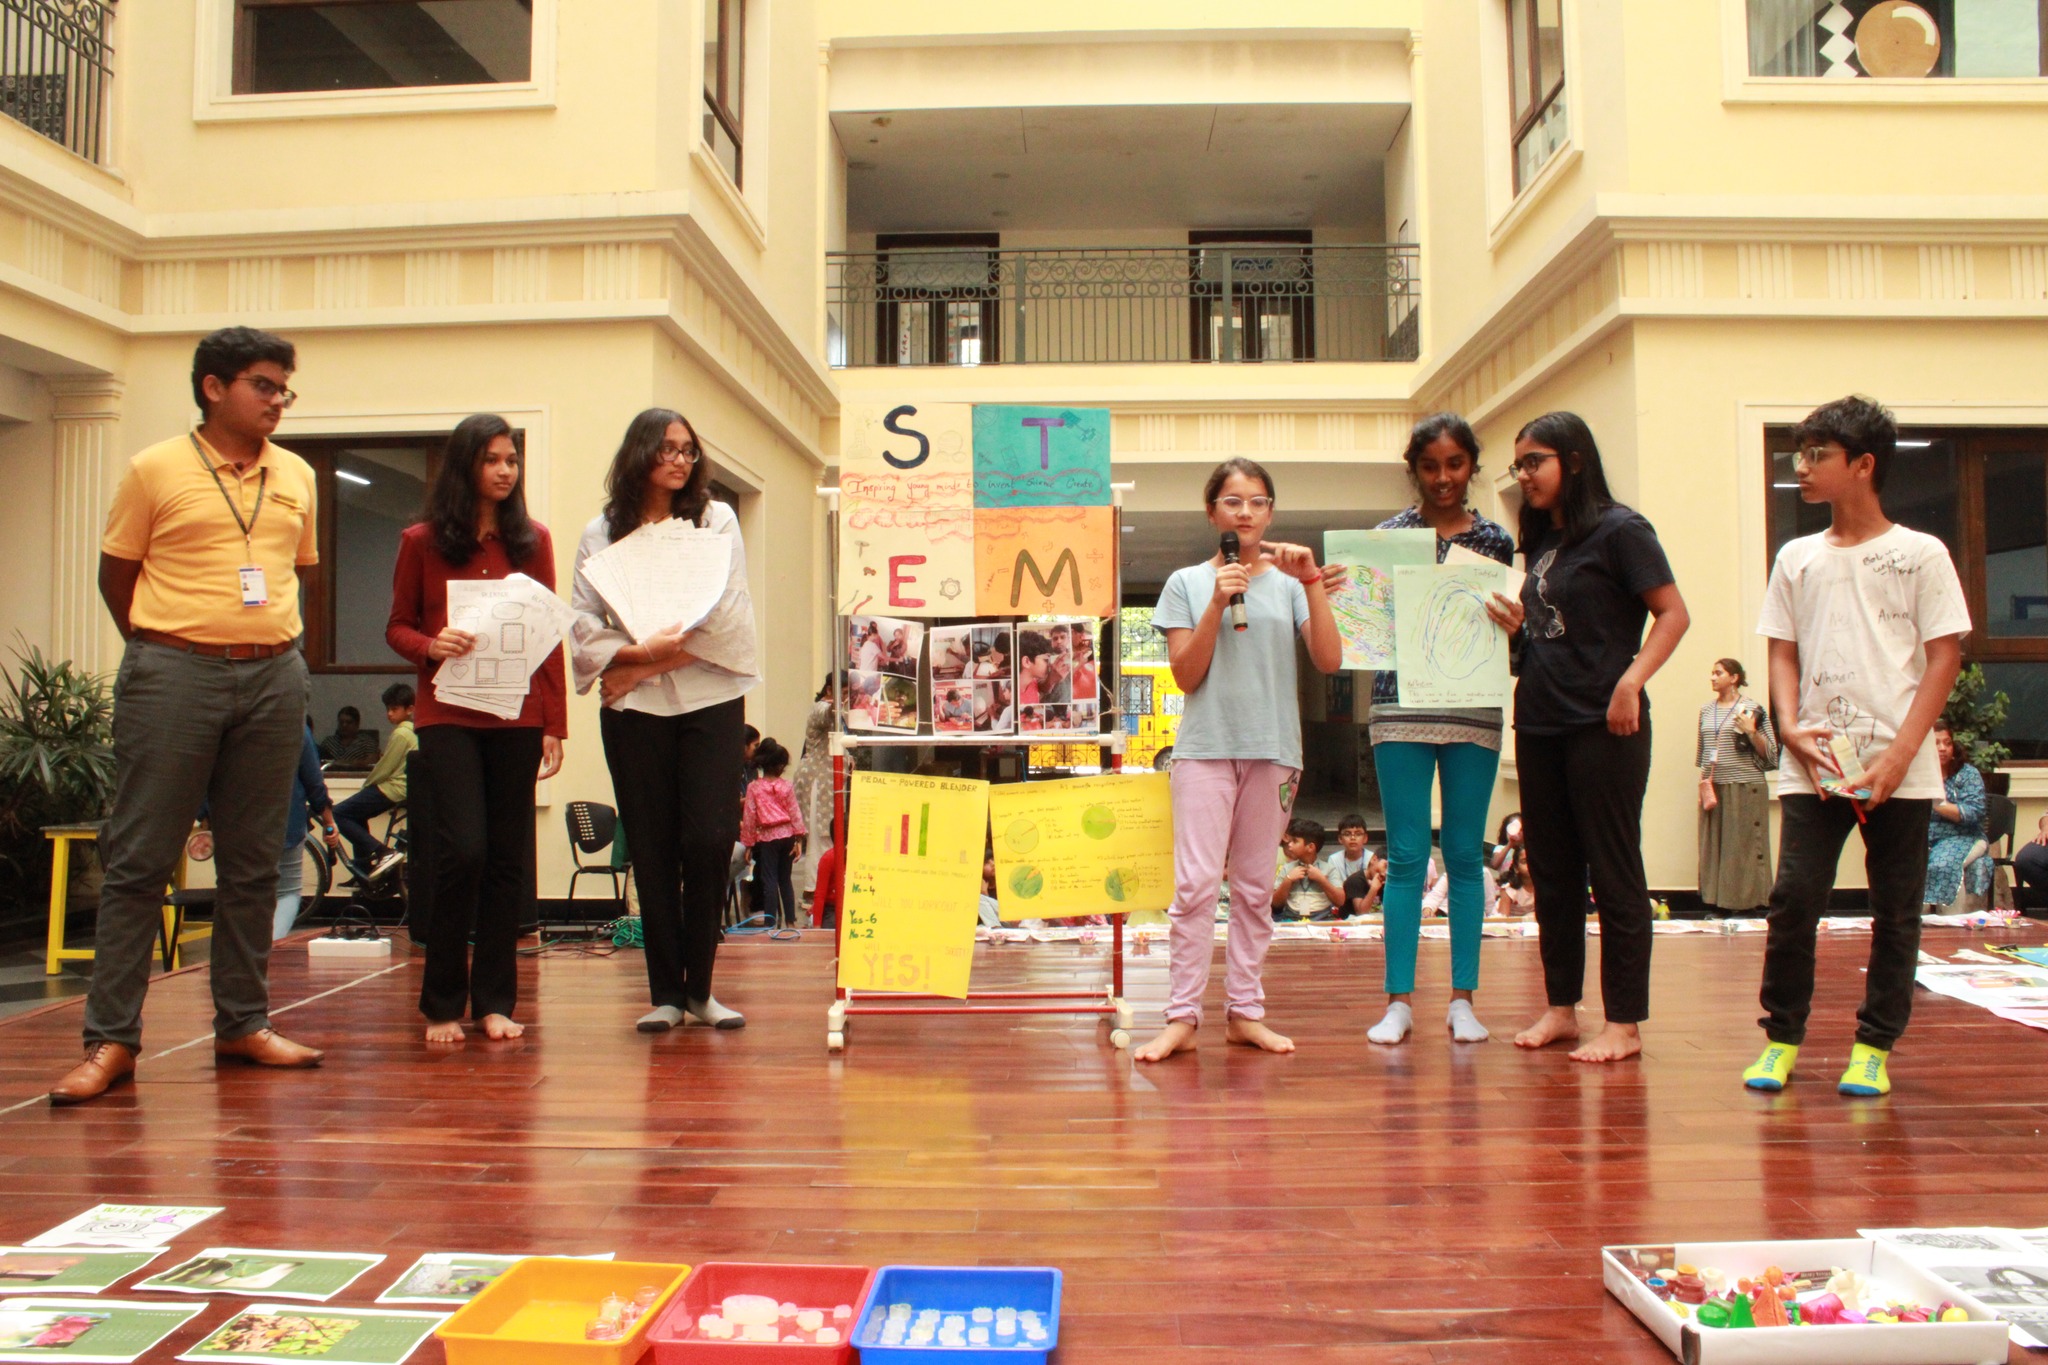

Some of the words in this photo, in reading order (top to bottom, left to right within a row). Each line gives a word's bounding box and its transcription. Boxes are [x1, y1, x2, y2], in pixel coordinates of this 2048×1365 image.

[882, 404, 930, 469] S
[1022, 417, 1064, 470] T
[848, 480, 896, 502] Inspiring
[907, 481, 930, 500] young
[888, 555, 927, 608] E
[1010, 547, 1083, 608] M
[860, 775, 887, 785] PEDAL
[899, 778, 936, 789] POWERED
[940, 781, 978, 792] BLENDER
[863, 953, 931, 990] YES!
